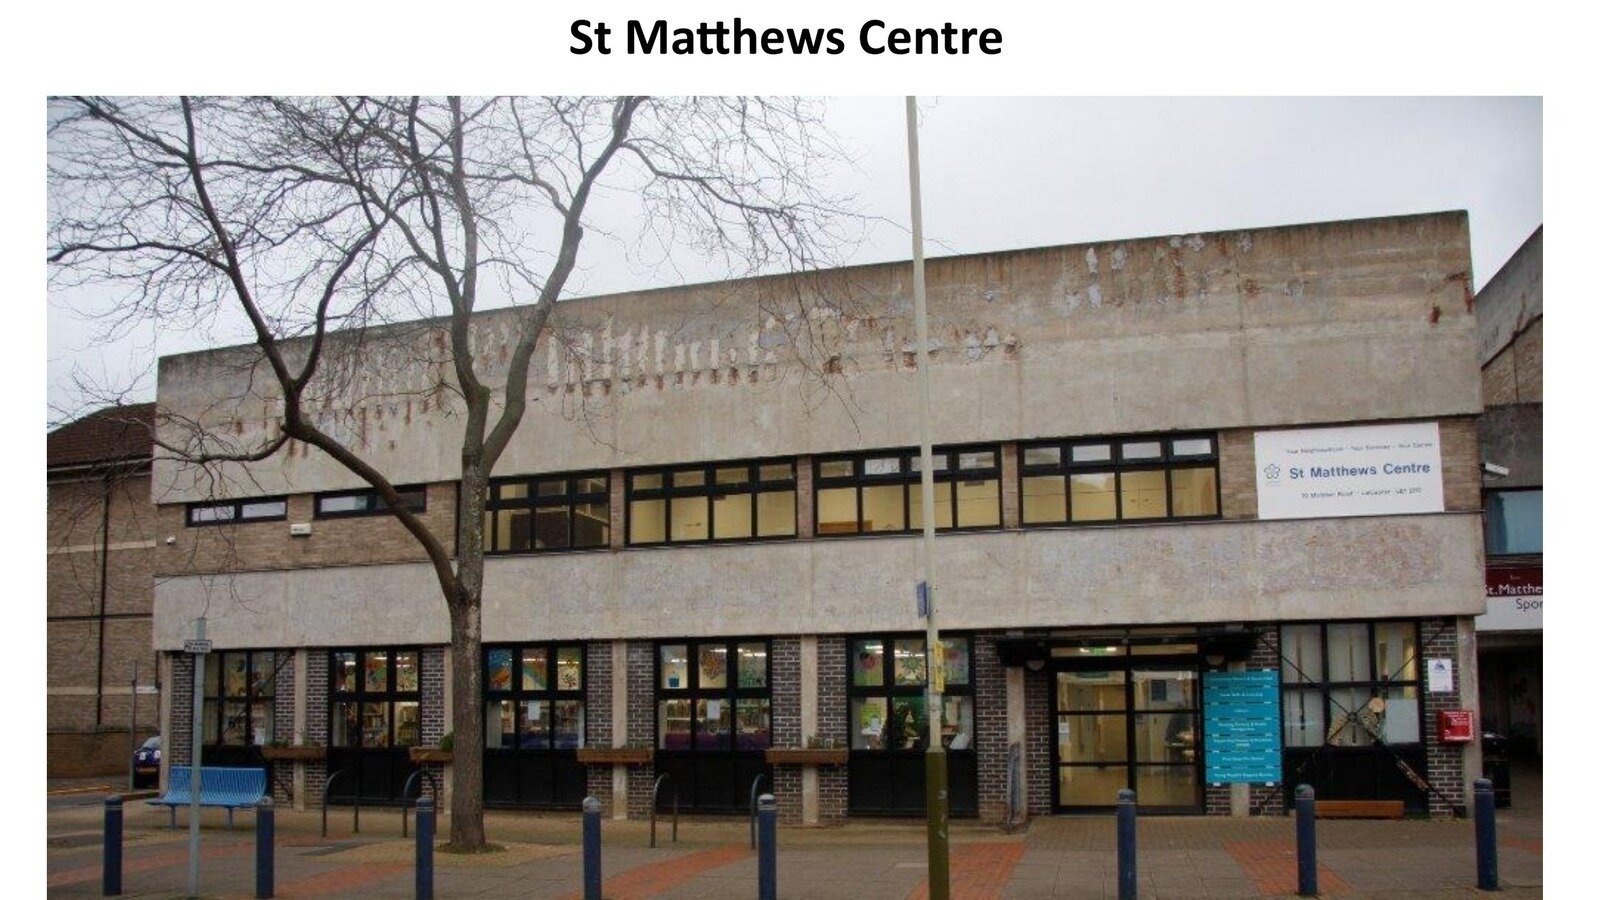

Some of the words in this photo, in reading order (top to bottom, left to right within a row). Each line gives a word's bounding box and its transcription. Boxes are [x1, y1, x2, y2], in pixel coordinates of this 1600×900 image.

[1289, 467, 1304, 479] St
[1310, 465, 1377, 478] Matthews
[1382, 463, 1431, 475] Centre
